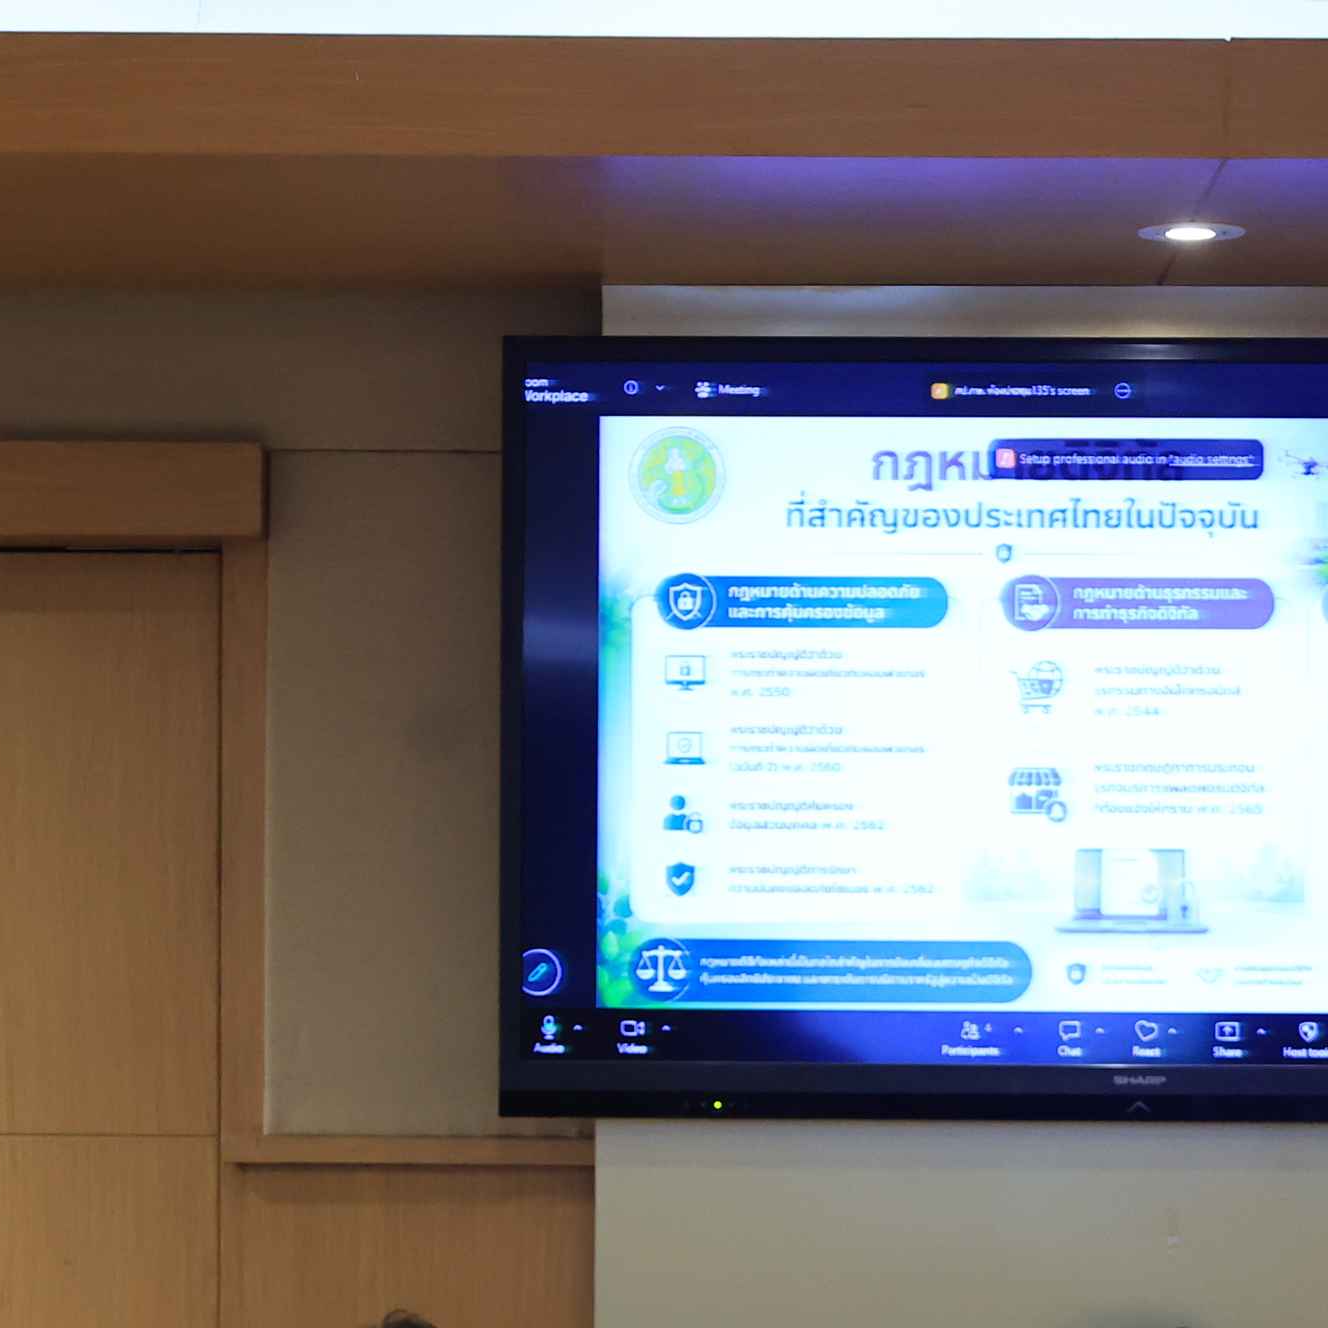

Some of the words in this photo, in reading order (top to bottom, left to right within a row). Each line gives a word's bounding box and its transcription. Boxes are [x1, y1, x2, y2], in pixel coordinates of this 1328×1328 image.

[524, 379, 549, 388] oom
[718, 384, 760, 397] Meeting
[1057, 387, 1091, 396] screen
[1019, 453, 1050, 467] Setup
[1053, 453, 1119, 467] professional
[1121, 453, 1153, 465] audio
[1156, 453, 1167, 465] in
[786, 490, 1259, 537] ที่สำคัญของประเทศไทยในปัจจุบัน
[728, 582, 922, 602] กฎหมายด้านความปลอดภัย
[1073, 583, 1249, 603] กฎหมายด้านธุรกรรมและ
[728, 603, 886, 623] และการคุ้มครองข้อมูล
[1073, 604, 1200, 624] การทำธุรกิจดิจิทัล
[759, 686, 791, 697] 2550
[533, 1042, 565, 1054] Audio
[616, 1042, 648, 1054] Video
[941, 1045, 999, 1058] Participants
[1058, 1046, 1082, 1057] Chat
[1132, 1046, 1161, 1057] React
[1213, 1046, 1242, 1058] Share
[1283, 1047, 1307, 1058] Host
[1113, 1075, 1167, 1085] SHARP
